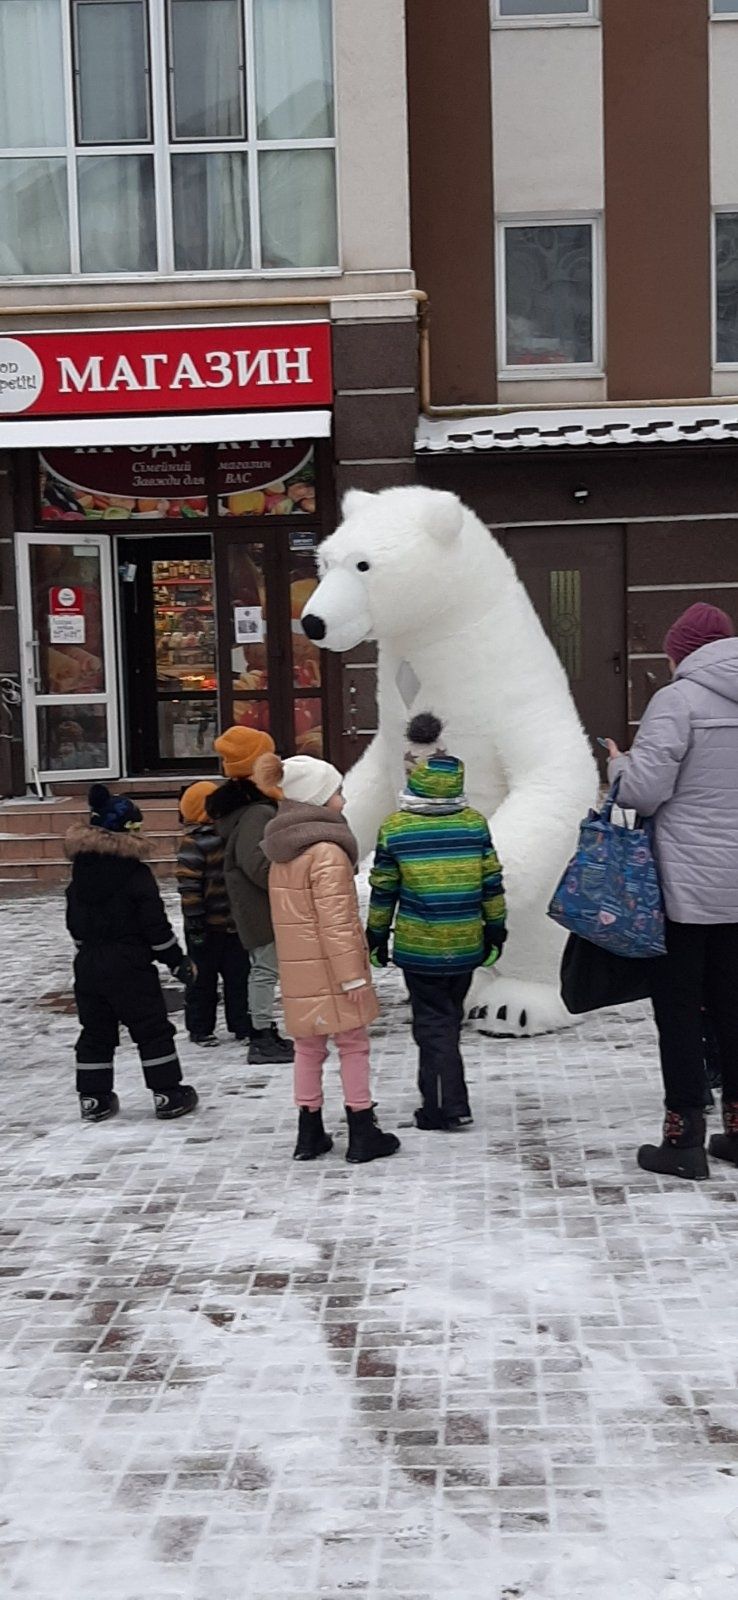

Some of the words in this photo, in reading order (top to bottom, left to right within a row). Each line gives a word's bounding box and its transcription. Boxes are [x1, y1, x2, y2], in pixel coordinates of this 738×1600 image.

[56, 347, 313, 393] МАГАЗИН
[131, 460, 192, 473] Сімейний
[218, 461, 272, 470] магазин
[132, 474, 181, 487] Завжди
[183, 473, 205, 485] для
[224, 473, 252, 484] ВАС
